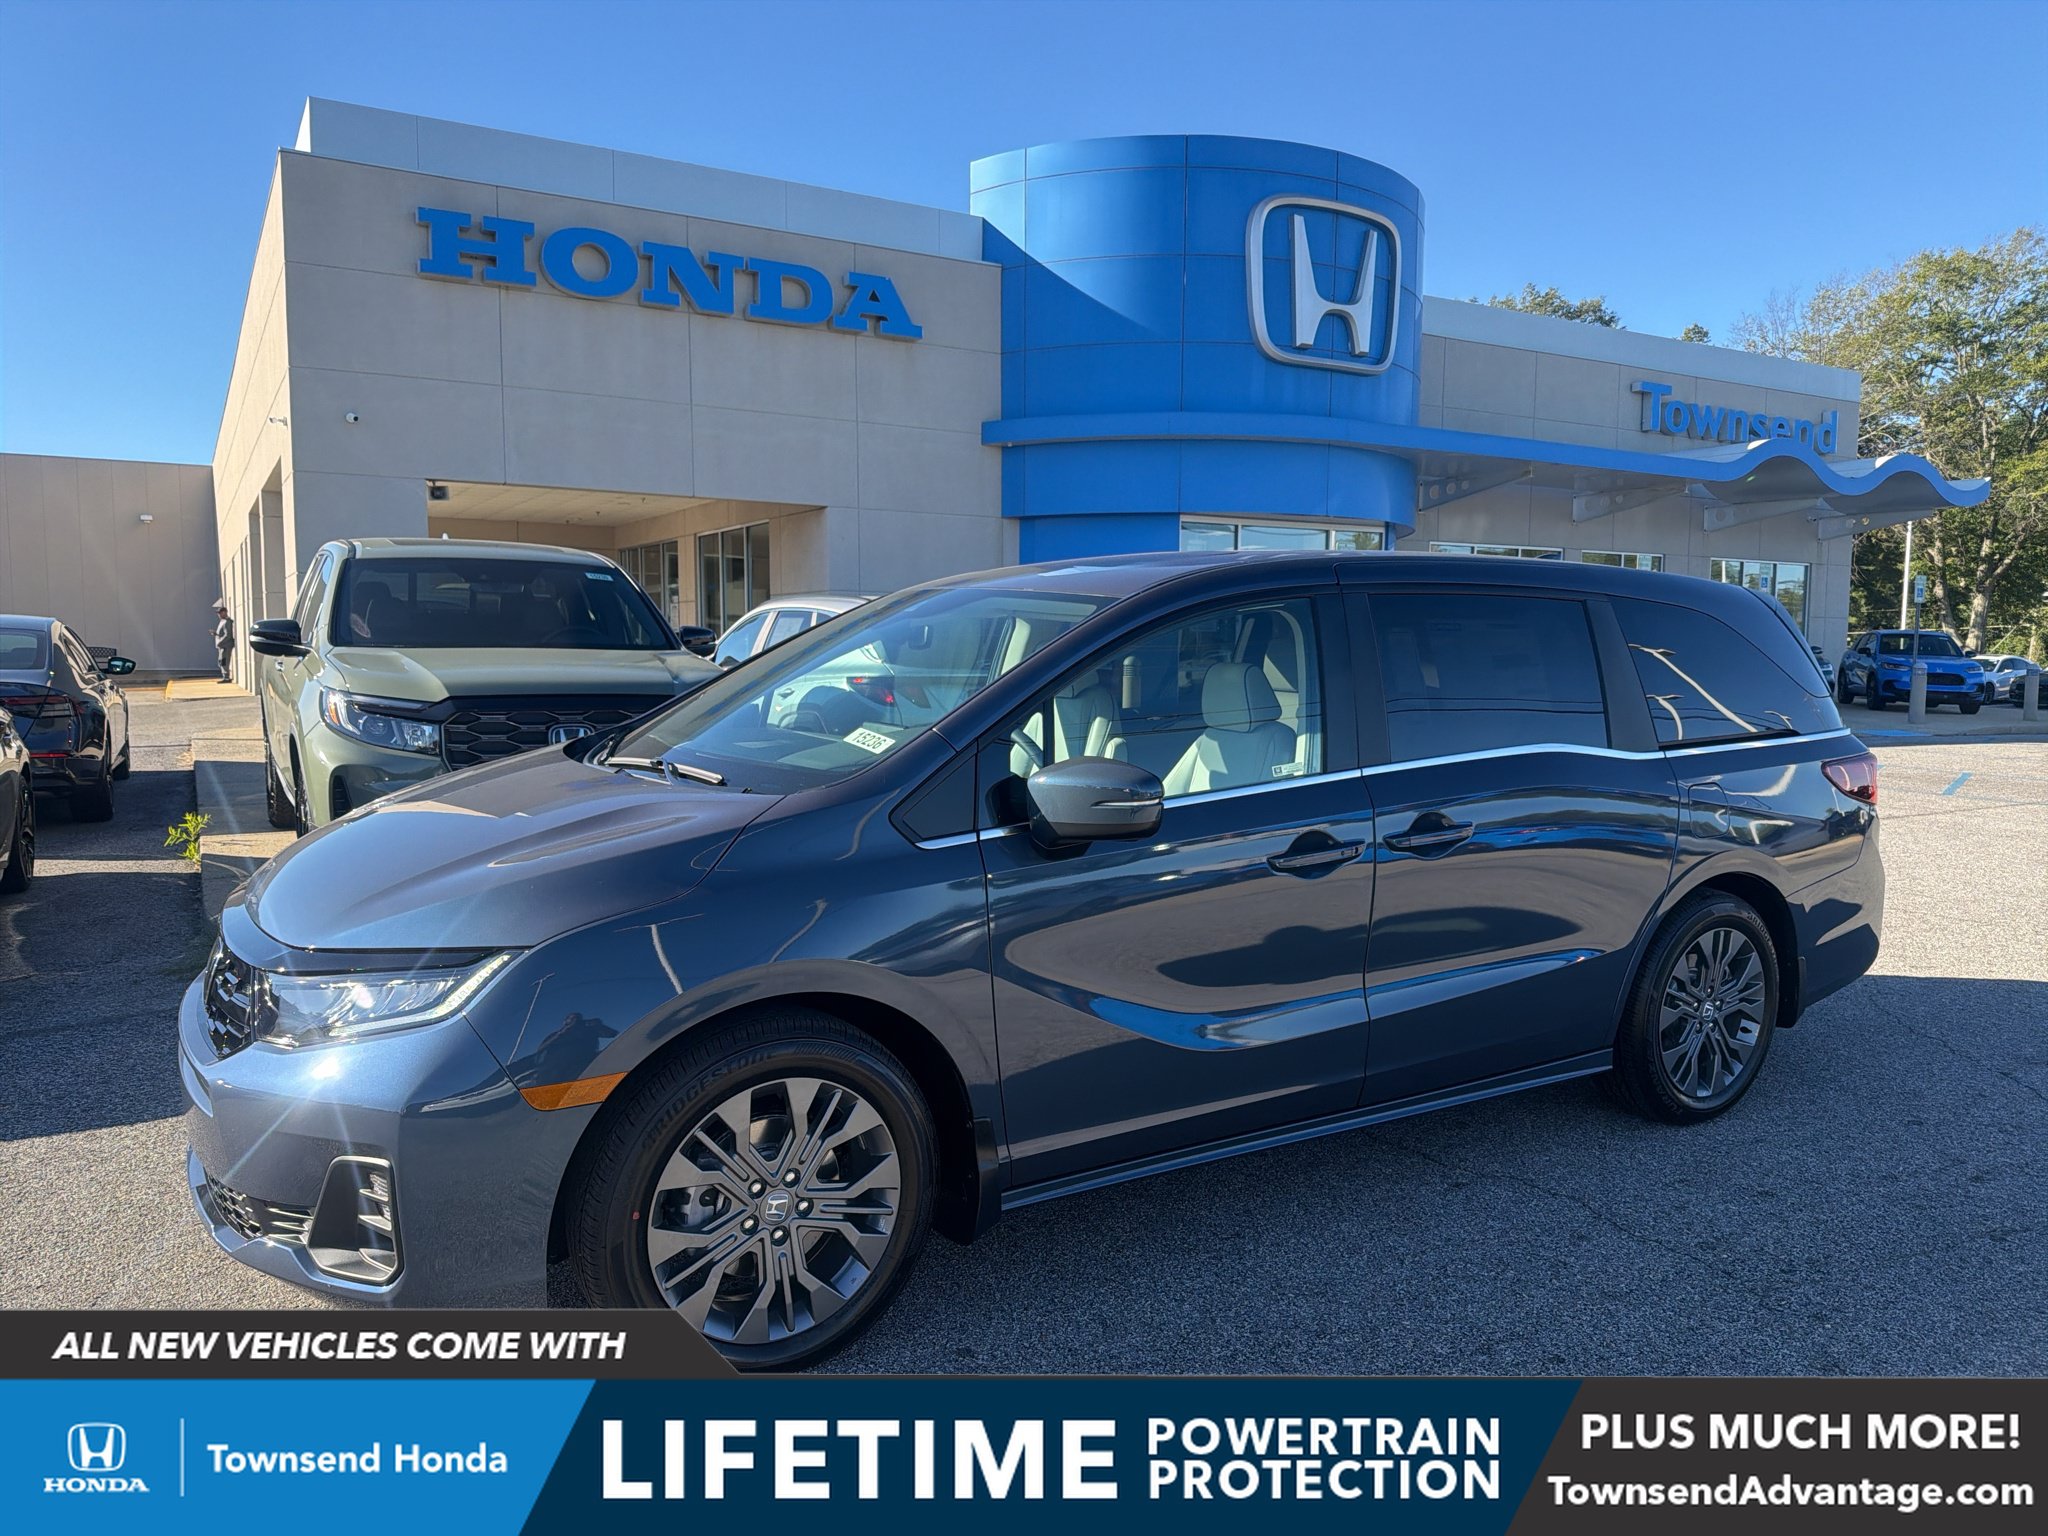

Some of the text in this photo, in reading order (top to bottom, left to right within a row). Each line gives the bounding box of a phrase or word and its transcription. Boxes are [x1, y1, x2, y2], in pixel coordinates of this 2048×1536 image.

[416, 206, 923, 342] HONDA
[1632, 380, 1839, 454] Townsend
[852, 731, 887, 750] 15236
